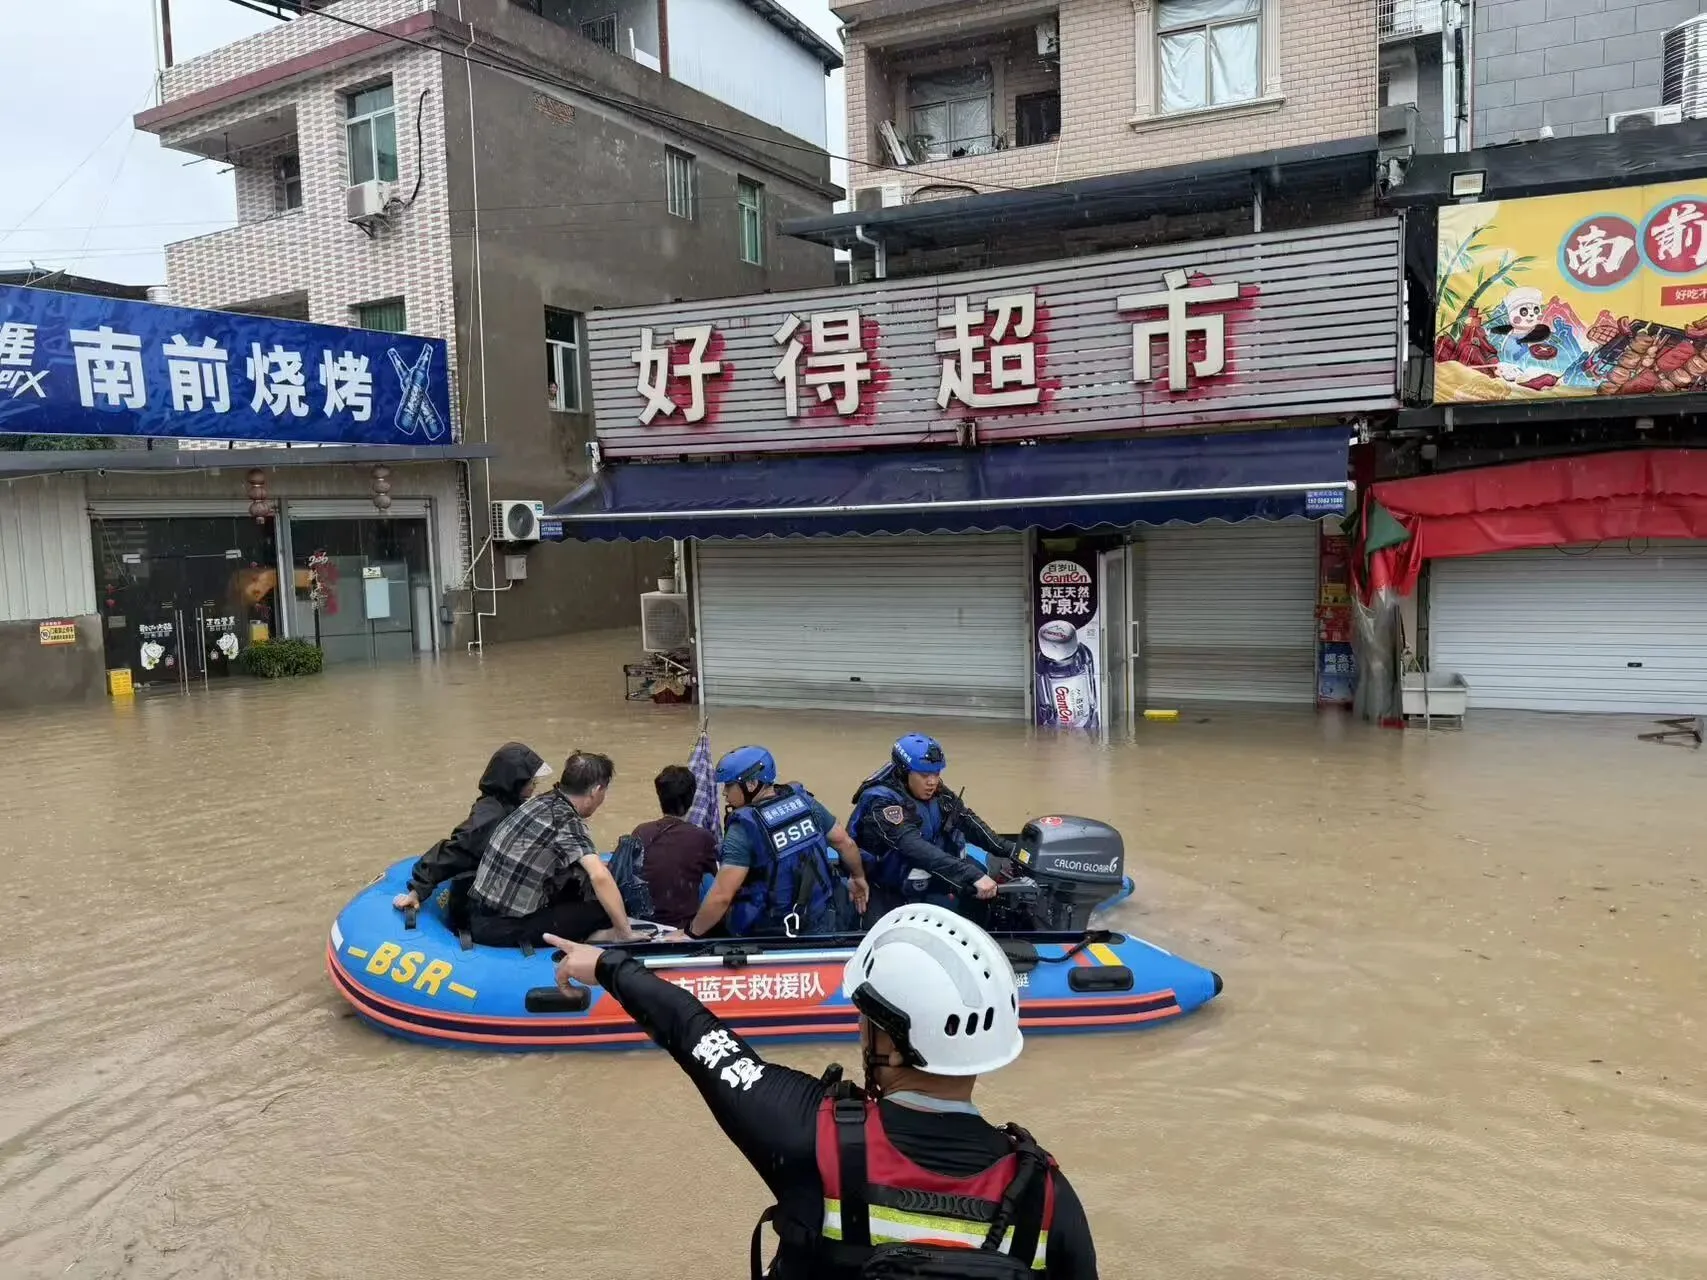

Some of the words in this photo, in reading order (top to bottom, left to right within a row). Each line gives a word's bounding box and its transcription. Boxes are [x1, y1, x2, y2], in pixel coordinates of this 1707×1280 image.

[631, 268, 1239, 424] 好得超市
[69, 325, 373, 421] 南前烧烤
[1048, 563, 1077, 573] 百岁山
[1040, 586, 1090, 598] 真正天然
[1041, 598, 1090, 615] 矿泉水
[772, 817, 816, 850] BSR
[1054, 858, 1081, 871] CALON
[664, 971, 825, 1002] 市蓝天救援队
